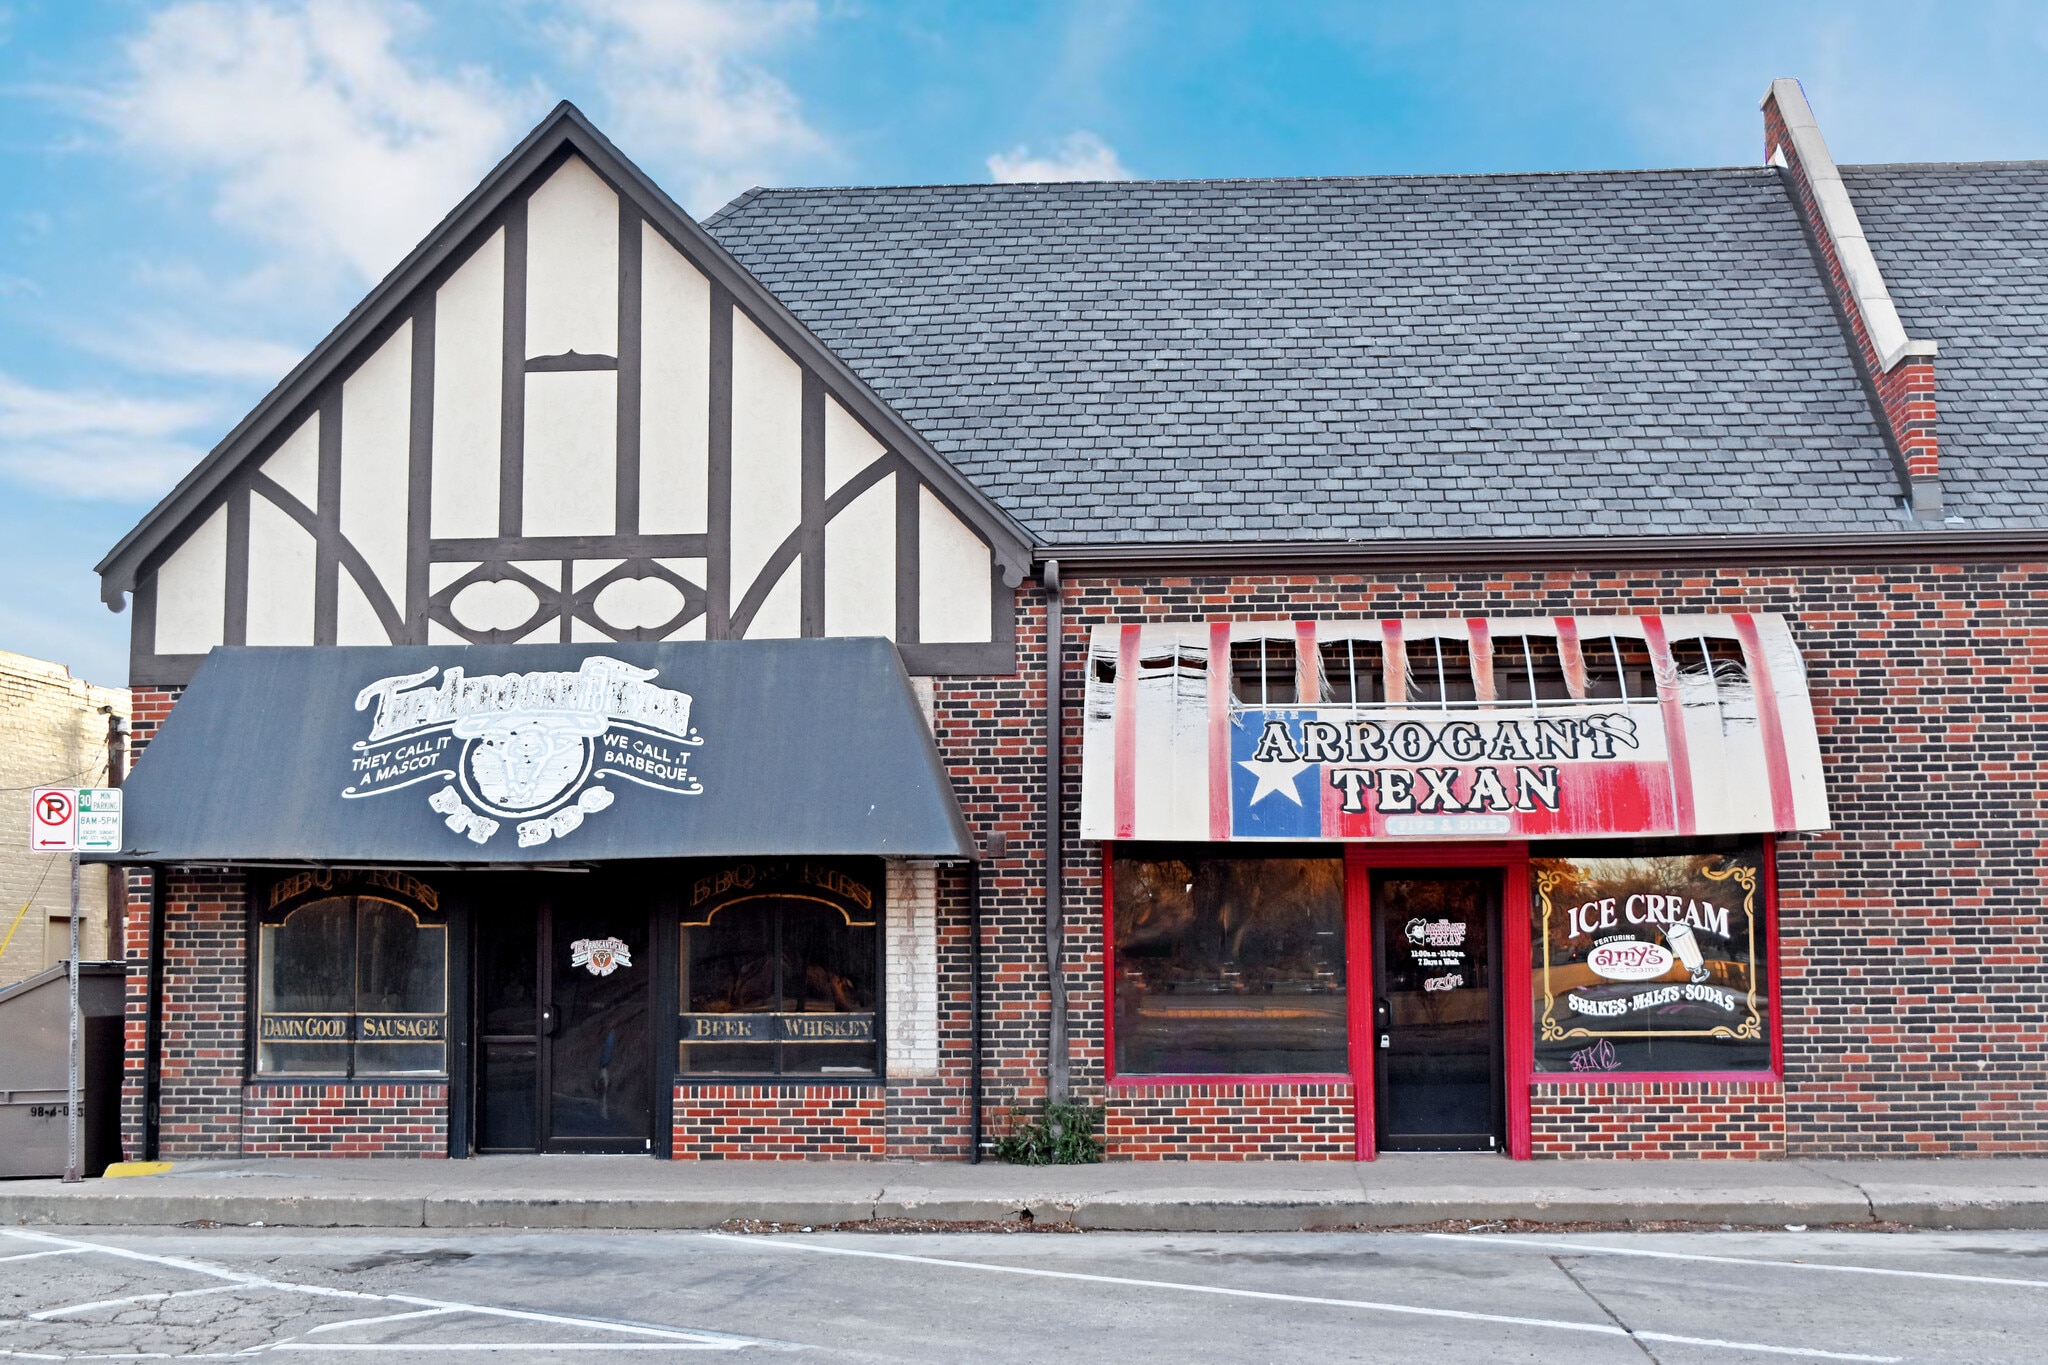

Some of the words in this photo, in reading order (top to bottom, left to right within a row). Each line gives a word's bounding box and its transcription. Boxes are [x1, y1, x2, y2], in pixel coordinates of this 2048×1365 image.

[352, 751, 392, 771] THEY
[395, 742, 434, 761] CALL
[436, 736, 452, 751] IT
[603, 734, 629, 750] WE
[632, 740, 672, 764] CALL
[1254, 717, 1618, 763] ARROGANT
[360, 771, 372, 786] A
[375, 753, 440, 783] MASCOT
[604, 750, 688, 781] BARBEQUE
[80, 795, 91, 806] 30
[100, 792, 111, 800] MIN
[1329, 766, 1562, 814] TEXAN
[80, 816, 118, 825] 8AM-5PM
[93, 802, 118, 810] PARKING
[1400, 820, 1435, 831] FIVE
[1440, 819, 1453, 832] &
[1460, 819, 1498, 831] DIME
[267, 868, 334, 911] BBQ
[365, 869, 440, 912] RIBS
[690, 863, 756, 907] BBQ
[797, 861, 873, 910] RIBS
[1567, 897, 1618, 939] ICE
[1625, 893, 1731, 938] CREAM
[1593, 934, 1636, 947] FEATURING
[1595, 944, 1664, 967] amy's
[1568, 993, 1627, 1017] SHAKES
[1632, 984, 1681, 1011] MALTS
[1685, 984, 1735, 1011] SODAS
[264, 1018, 304, 1037] DAMN
[305, 1017, 346, 1037] GOOD
[363, 1018, 438, 1037] SAUSAGE
[784, 1018, 873, 1037] WHISKEY
